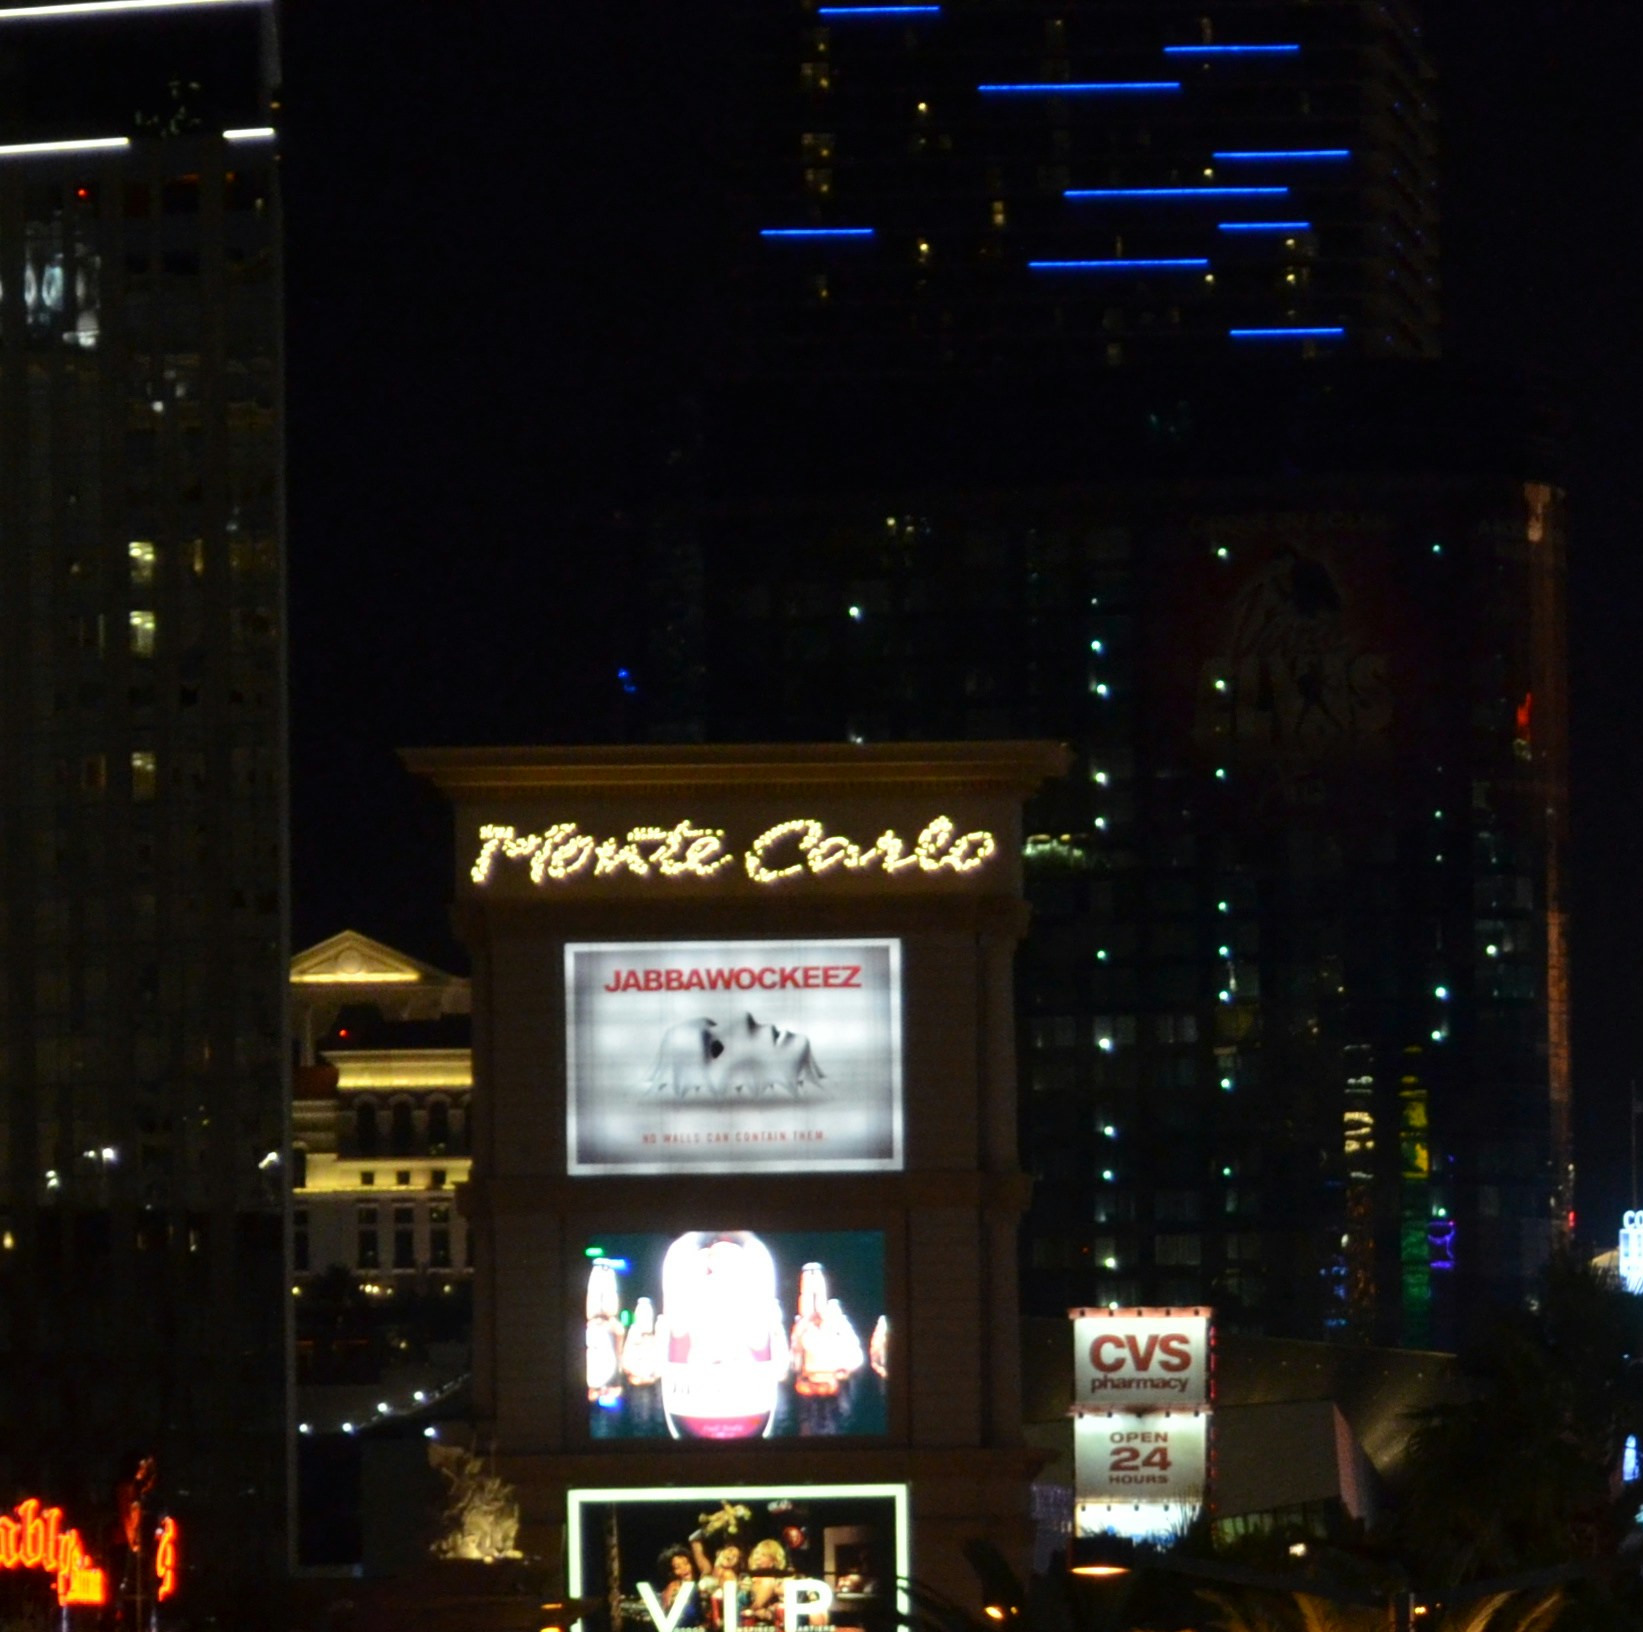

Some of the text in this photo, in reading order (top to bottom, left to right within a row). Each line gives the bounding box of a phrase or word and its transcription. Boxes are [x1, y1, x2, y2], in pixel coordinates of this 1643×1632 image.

[470, 814, 997, 886] Monte Carlo
[603, 965, 862, 993] JABBAWOCKEEZ
[735, 1130, 788, 1144] CONTAIN
[1089, 1333, 1192, 1374] CVS
[1090, 1375, 1189, 1394] pharmacy
[1109, 1431, 1169, 1444] OPEN
[1108, 1446, 1172, 1472] 24
[1108, 1474, 1169, 1485] HOURS
